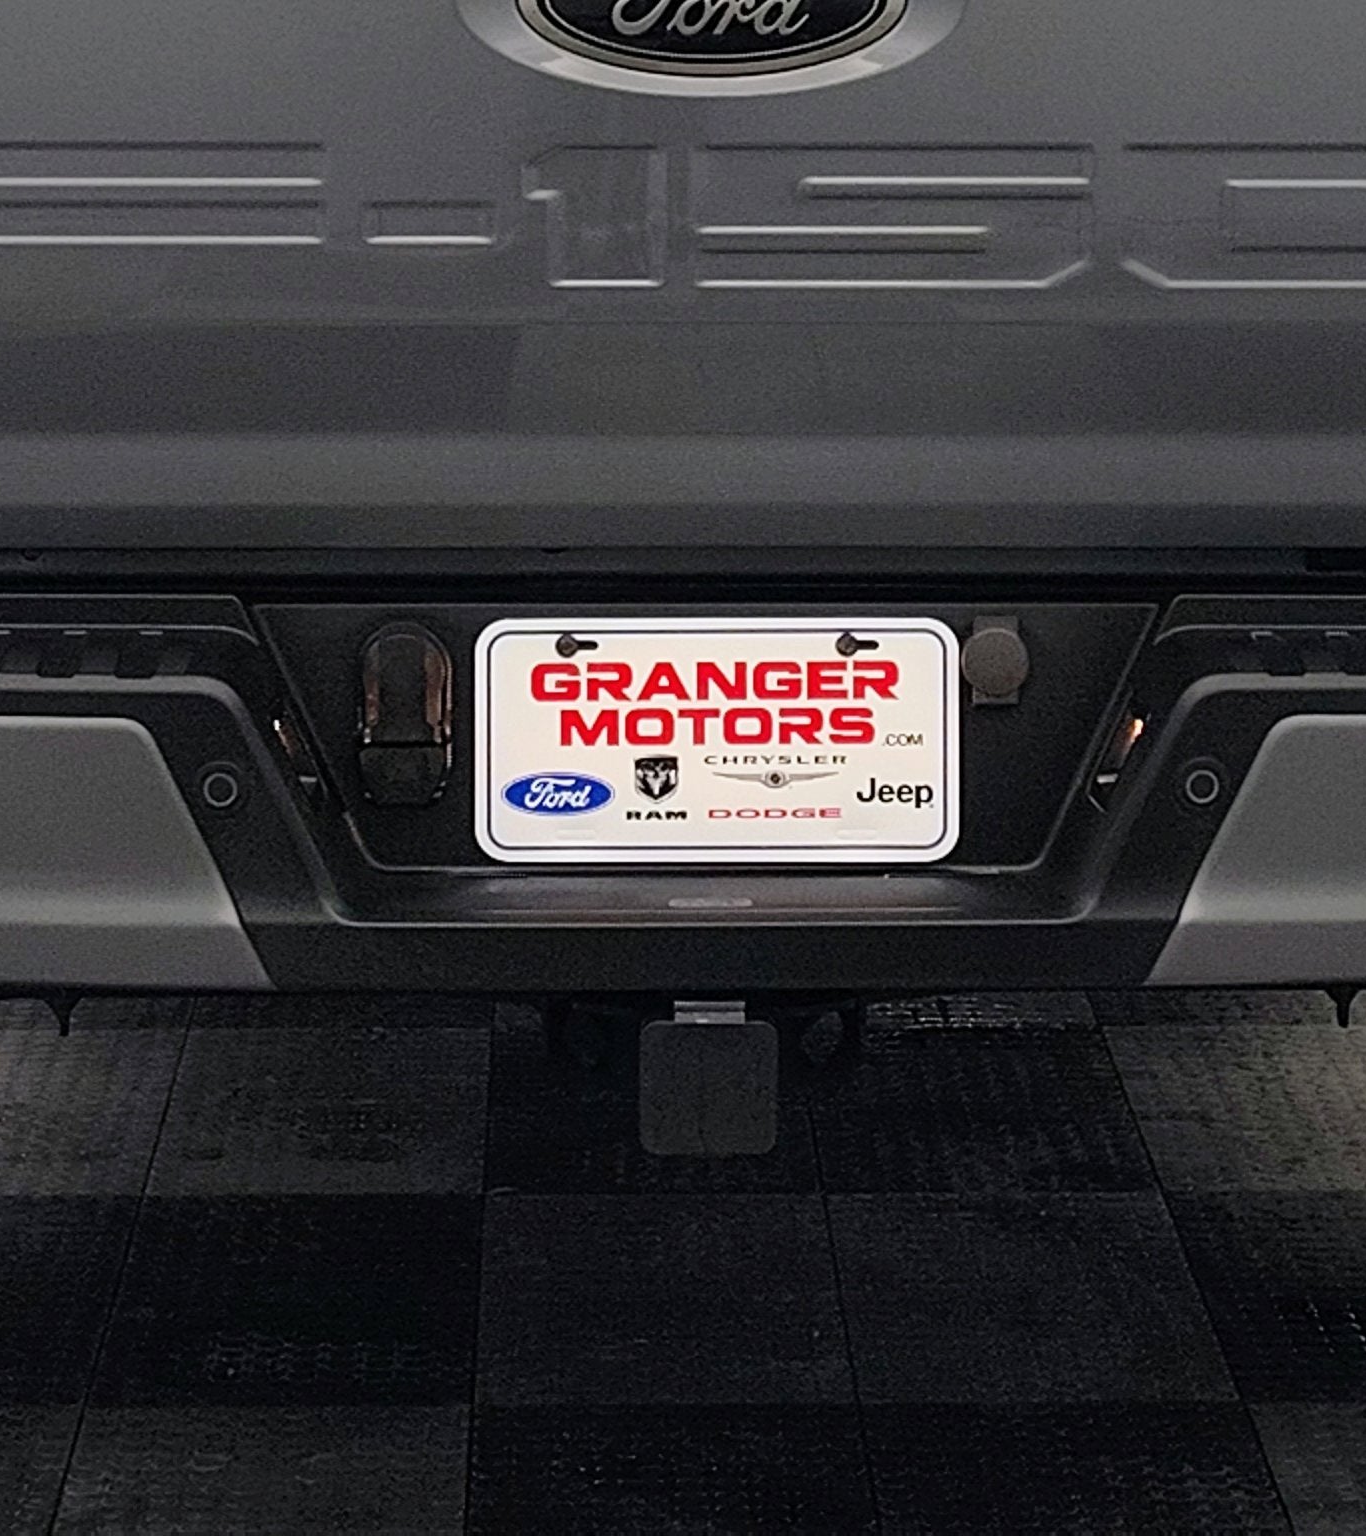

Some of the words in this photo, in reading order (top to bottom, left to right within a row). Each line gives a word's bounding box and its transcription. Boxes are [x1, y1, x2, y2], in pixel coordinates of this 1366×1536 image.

[530, 660, 899, 701] GRANGER
[560, 707, 875, 746] MOTORS
[881, 732, 924, 747] .COM
[703, 754, 848, 765] CHRYSLER
[523, 777, 592, 809] Ford
[856, 777, 934, 809] Jeep
[625, 809, 688, 821] RAM
[707, 807, 842, 819] DODGE
